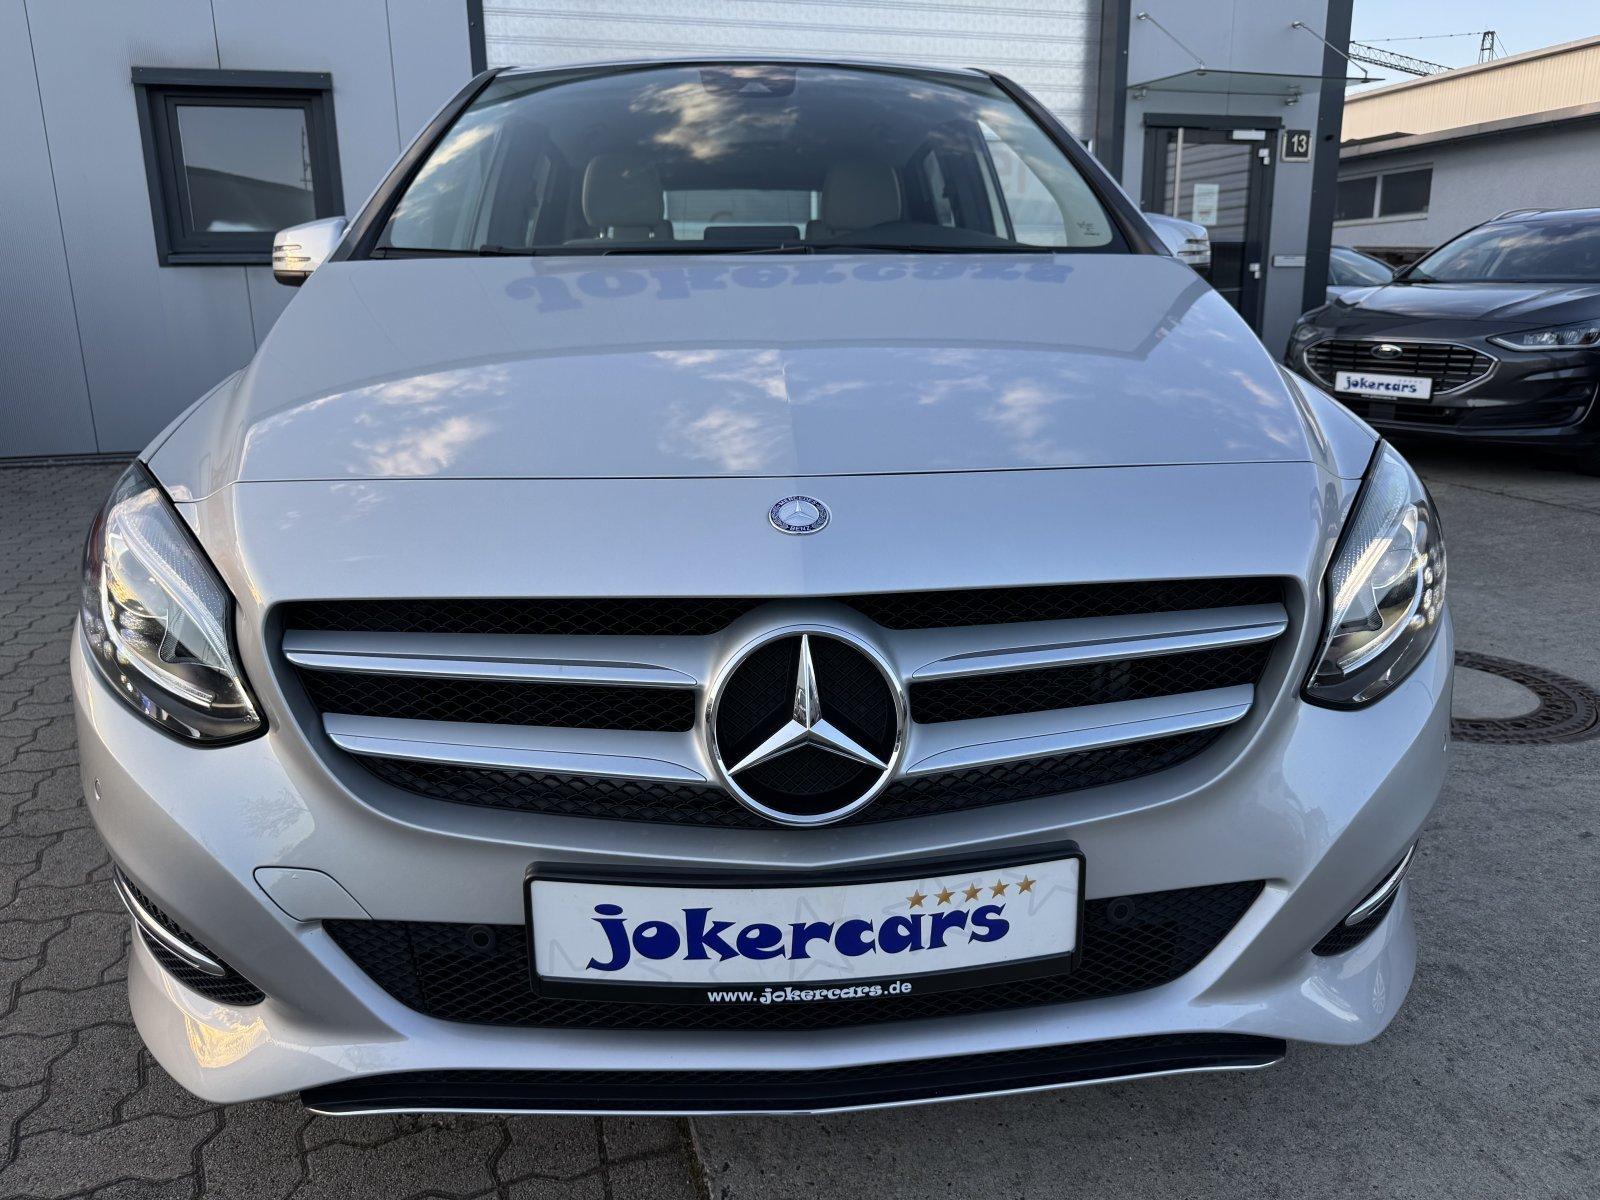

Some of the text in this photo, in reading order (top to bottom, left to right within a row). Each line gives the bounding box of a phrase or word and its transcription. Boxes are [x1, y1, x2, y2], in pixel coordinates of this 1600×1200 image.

[1291, 134, 1307, 153] 13
[1344, 376, 1417, 393] jokercars
[586, 903, 1010, 971] jokercars
[707, 981, 912, 1005] www.jokercars.de
